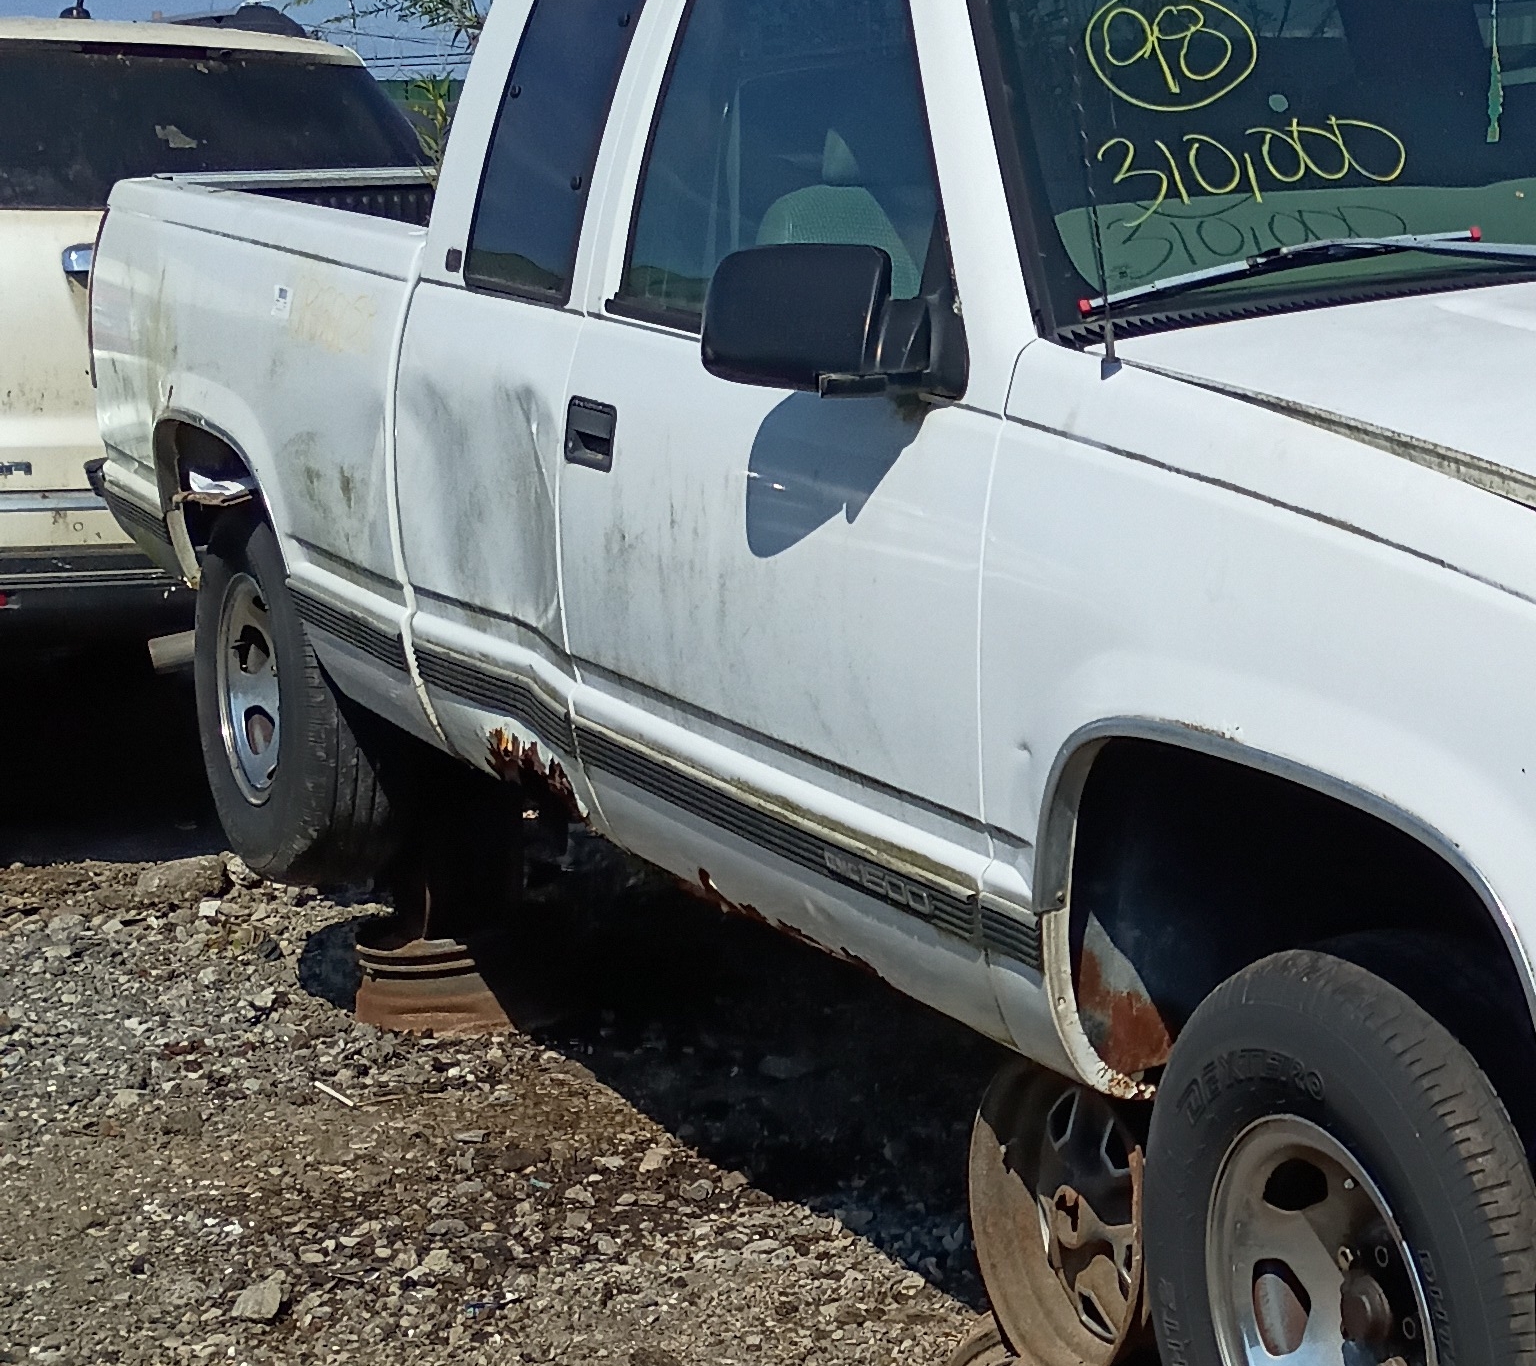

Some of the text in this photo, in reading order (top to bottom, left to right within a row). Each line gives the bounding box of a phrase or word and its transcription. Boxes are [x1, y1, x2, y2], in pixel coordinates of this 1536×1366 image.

[1104, 6, 1232, 94] 98
[1098, 116, 1407, 227] 310,000
[1176, 1048, 1325, 1126] DEXTERO
